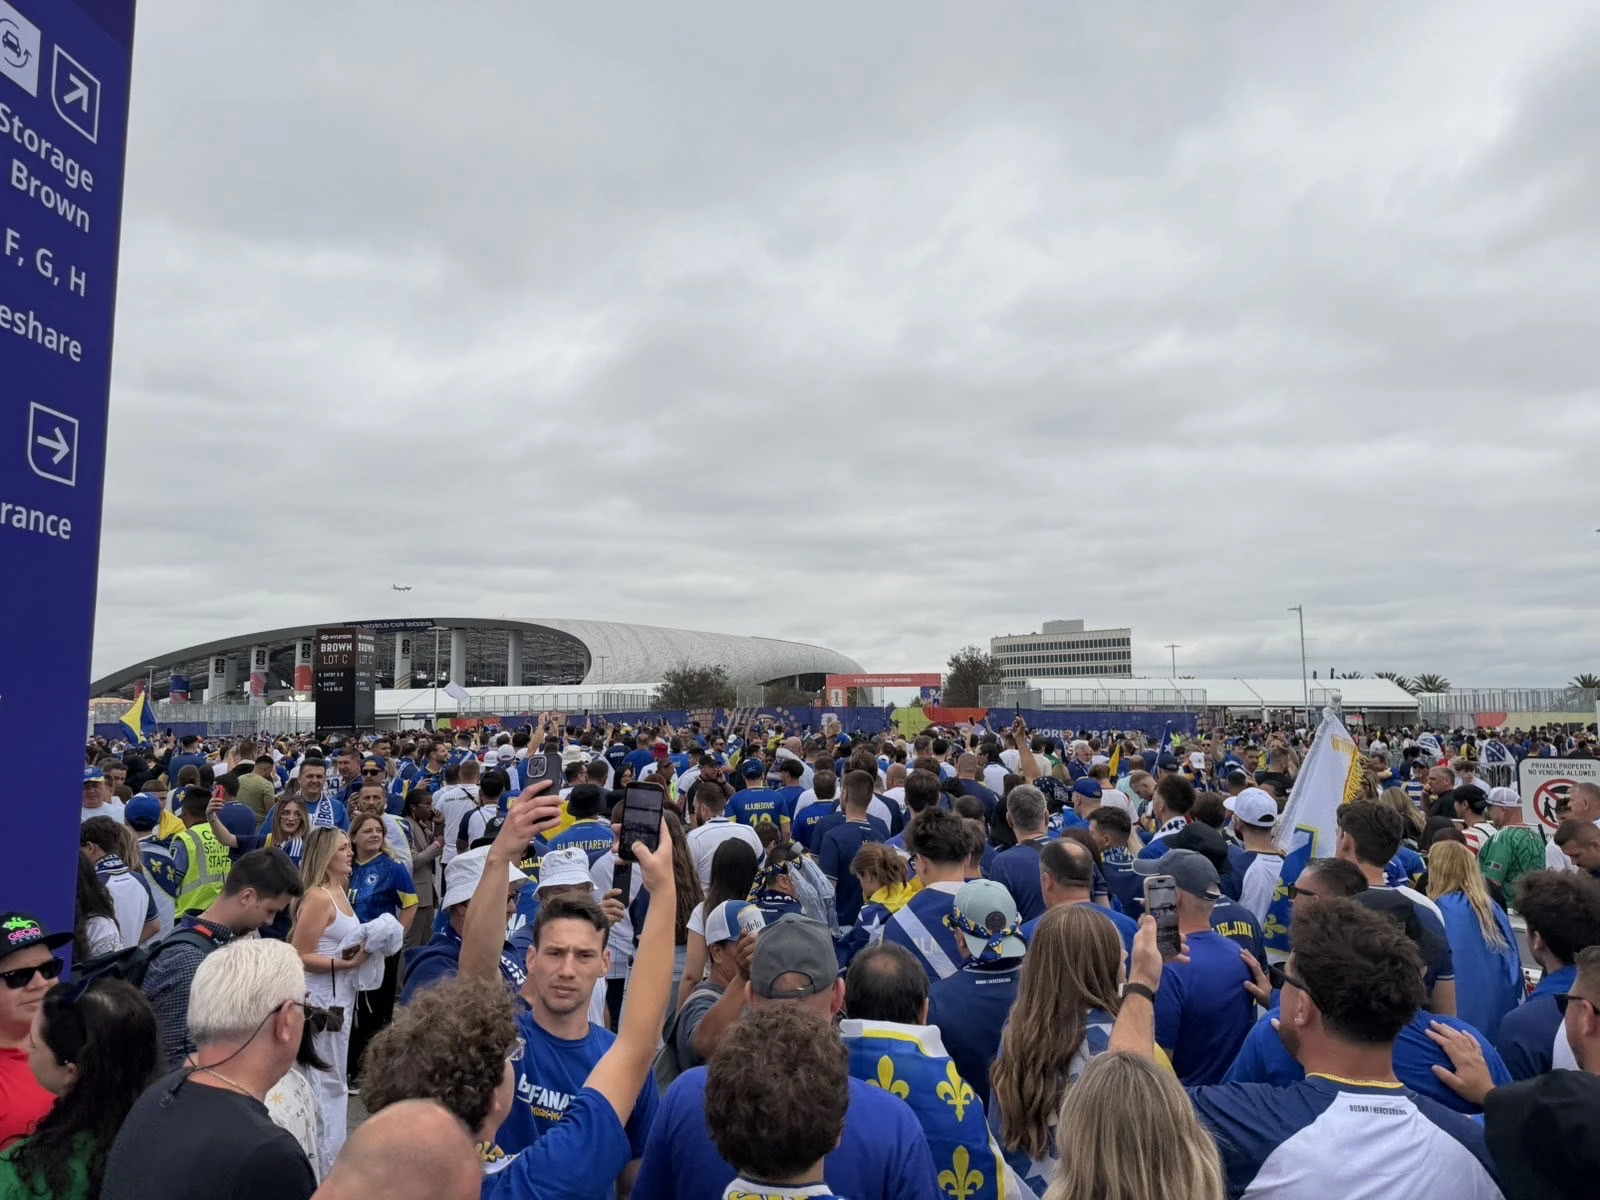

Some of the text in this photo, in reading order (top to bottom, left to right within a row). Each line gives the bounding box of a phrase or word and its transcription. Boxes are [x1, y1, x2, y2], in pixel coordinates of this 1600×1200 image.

[0, 103, 94, 192] Storage
[11, 158, 90, 233] Brown
[5, 227, 86, 297] F, G, H
[320, 642, 352, 653] BROWN
[323, 654, 349, 665] LOT C
[208, 855, 231, 868] STAFF
[742, 919, 762, 933] delo
[8, 927, 41, 940] GECKO
